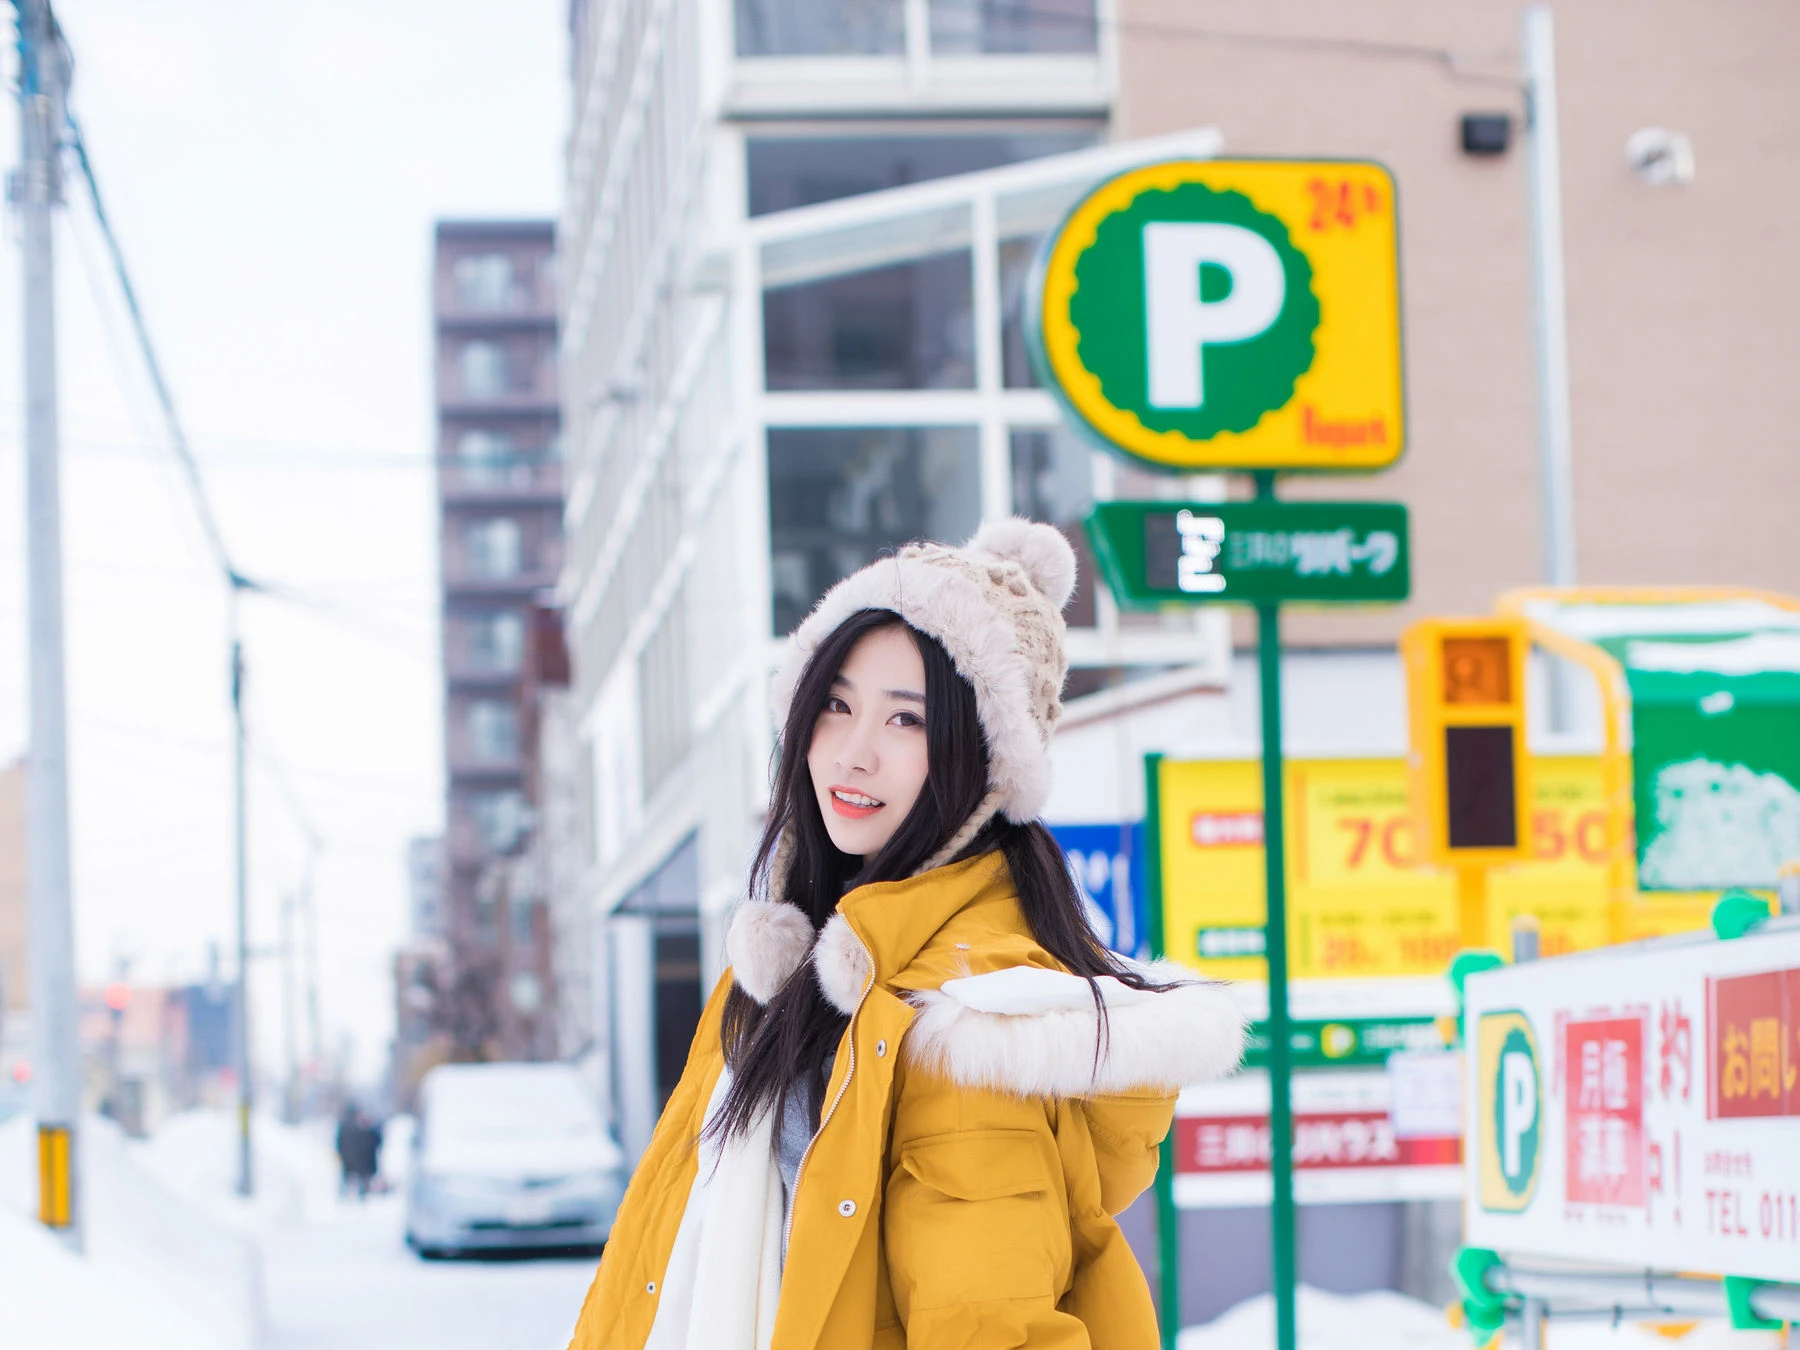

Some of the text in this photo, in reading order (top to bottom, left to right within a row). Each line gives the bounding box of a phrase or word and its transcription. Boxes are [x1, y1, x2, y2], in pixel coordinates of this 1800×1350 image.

[1142, 221, 1286, 410] P
[1504, 1050, 1537, 1178] P
[1704, 1189, 1749, 1236] TEL
